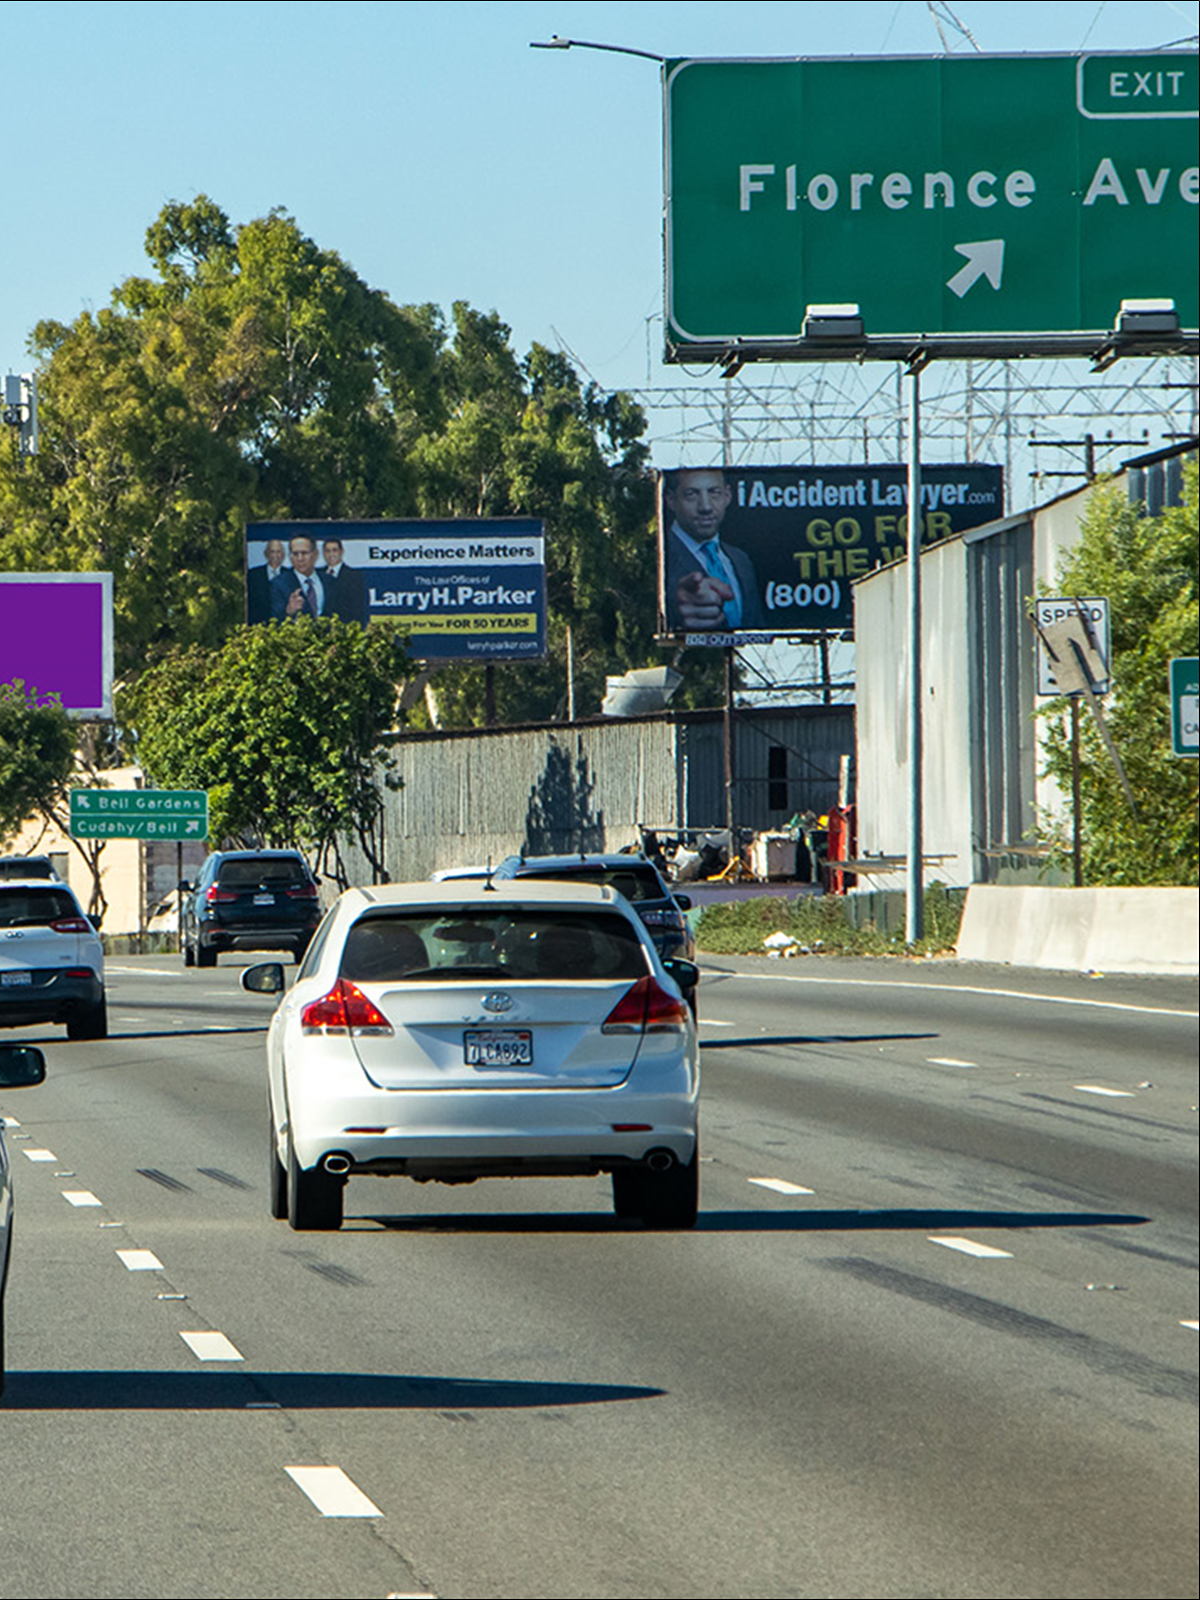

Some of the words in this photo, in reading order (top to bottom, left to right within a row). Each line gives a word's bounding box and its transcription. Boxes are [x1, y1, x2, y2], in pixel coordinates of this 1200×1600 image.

[1109, 71, 1185, 97] EXIT
[739, 163, 1036, 211] Florence
[1082, 157, 1199, 205] Ave
[805, 517, 862, 546] GO
[368, 545, 466, 562] Experience
[469, 544, 535, 558] Matters
[793, 548, 870, 579] THE
[414, 575, 431, 585] The
[368, 587, 430, 611] Larry
[457, 585, 537, 606] Parker
[765, 580, 841, 610] (800)
[446, 618, 471, 629] FOR
[473, 618, 488, 629] 50
[490, 618, 529, 628] YEARS
[99, 797, 129, 809] Bell
[136, 797, 200, 809] Gardens
[77, 821, 178, 836] Cudahy/Bell
